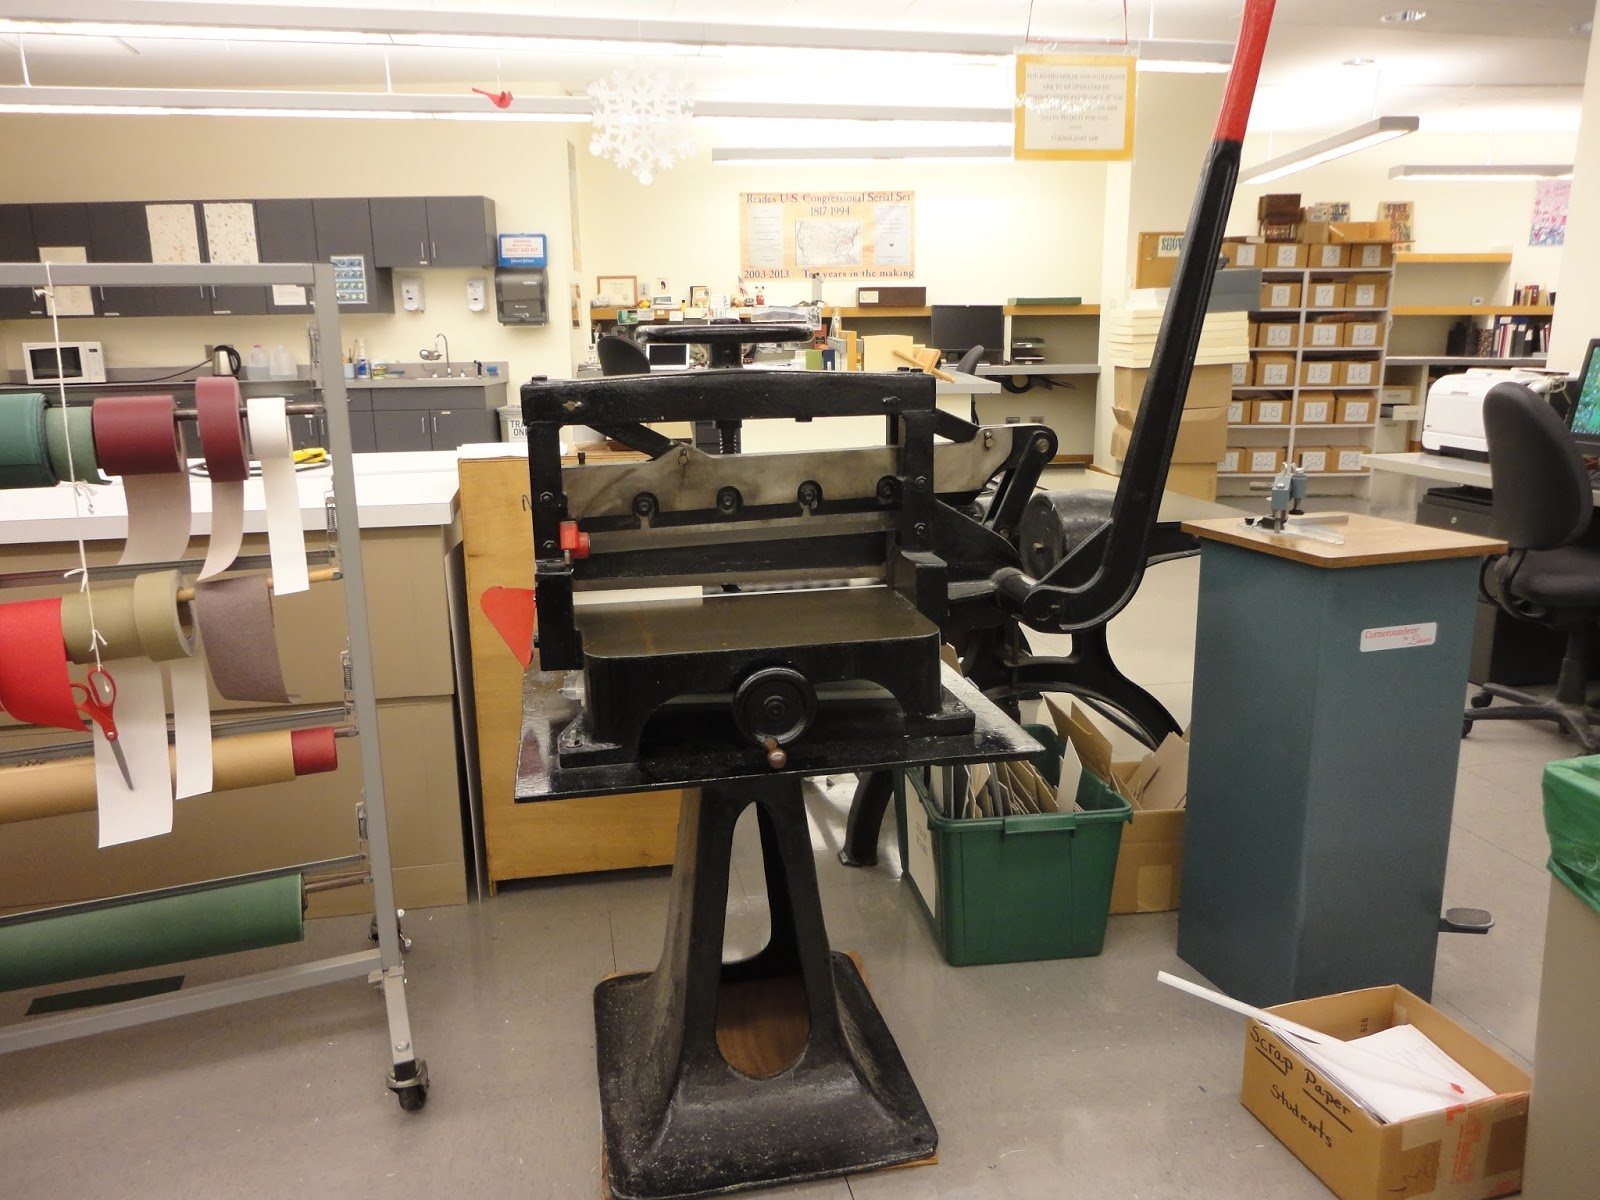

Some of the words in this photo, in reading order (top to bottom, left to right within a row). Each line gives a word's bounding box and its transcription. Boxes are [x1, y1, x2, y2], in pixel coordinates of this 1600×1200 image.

[746, 193, 777, 204] Readex
[780, 193, 799, 204] U.S.
[802, 192, 865, 205] Congressional
[867, 191, 893, 202] Serial
[895, 191, 910, 202] Set
[1161, 237, 1183, 251] SHO
[1281, 249, 1293, 262] 2
[1326, 249, 1338, 263] 3
[1367, 249, 1377, 262] 4
[862, 269, 876, 277] the
[880, 269, 914, 279] making
[1275, 288, 1286, 302] 6
[1320, 289, 1331, 302] 7
[1360, 288, 1371, 301] 8
[1271, 328, 1288, 342] 10
[1317, 328, 1331, 341] 11
[1356, 328, 1374, 342] 12
[1268, 367, 1284, 380] 14
[1311, 366, 1328, 379] 15
[1350, 366, 1368, 379] 16
[1263, 405, 1279, 418] 18
[1307, 405, 1324, 418] 19
[1347, 405, 1366, 418] 20
[510, 420, 525, 428] TRA
[1255, 455, 1273, 468] 22
[1303, 455, 1323, 468] 23
[1340, 454, 1359, 467] 24
[1250, 1025, 1293, 1074] Scrap
[1304, 1069, 1350, 1115] Paper
[1270, 1084, 1332, 1148] Students
